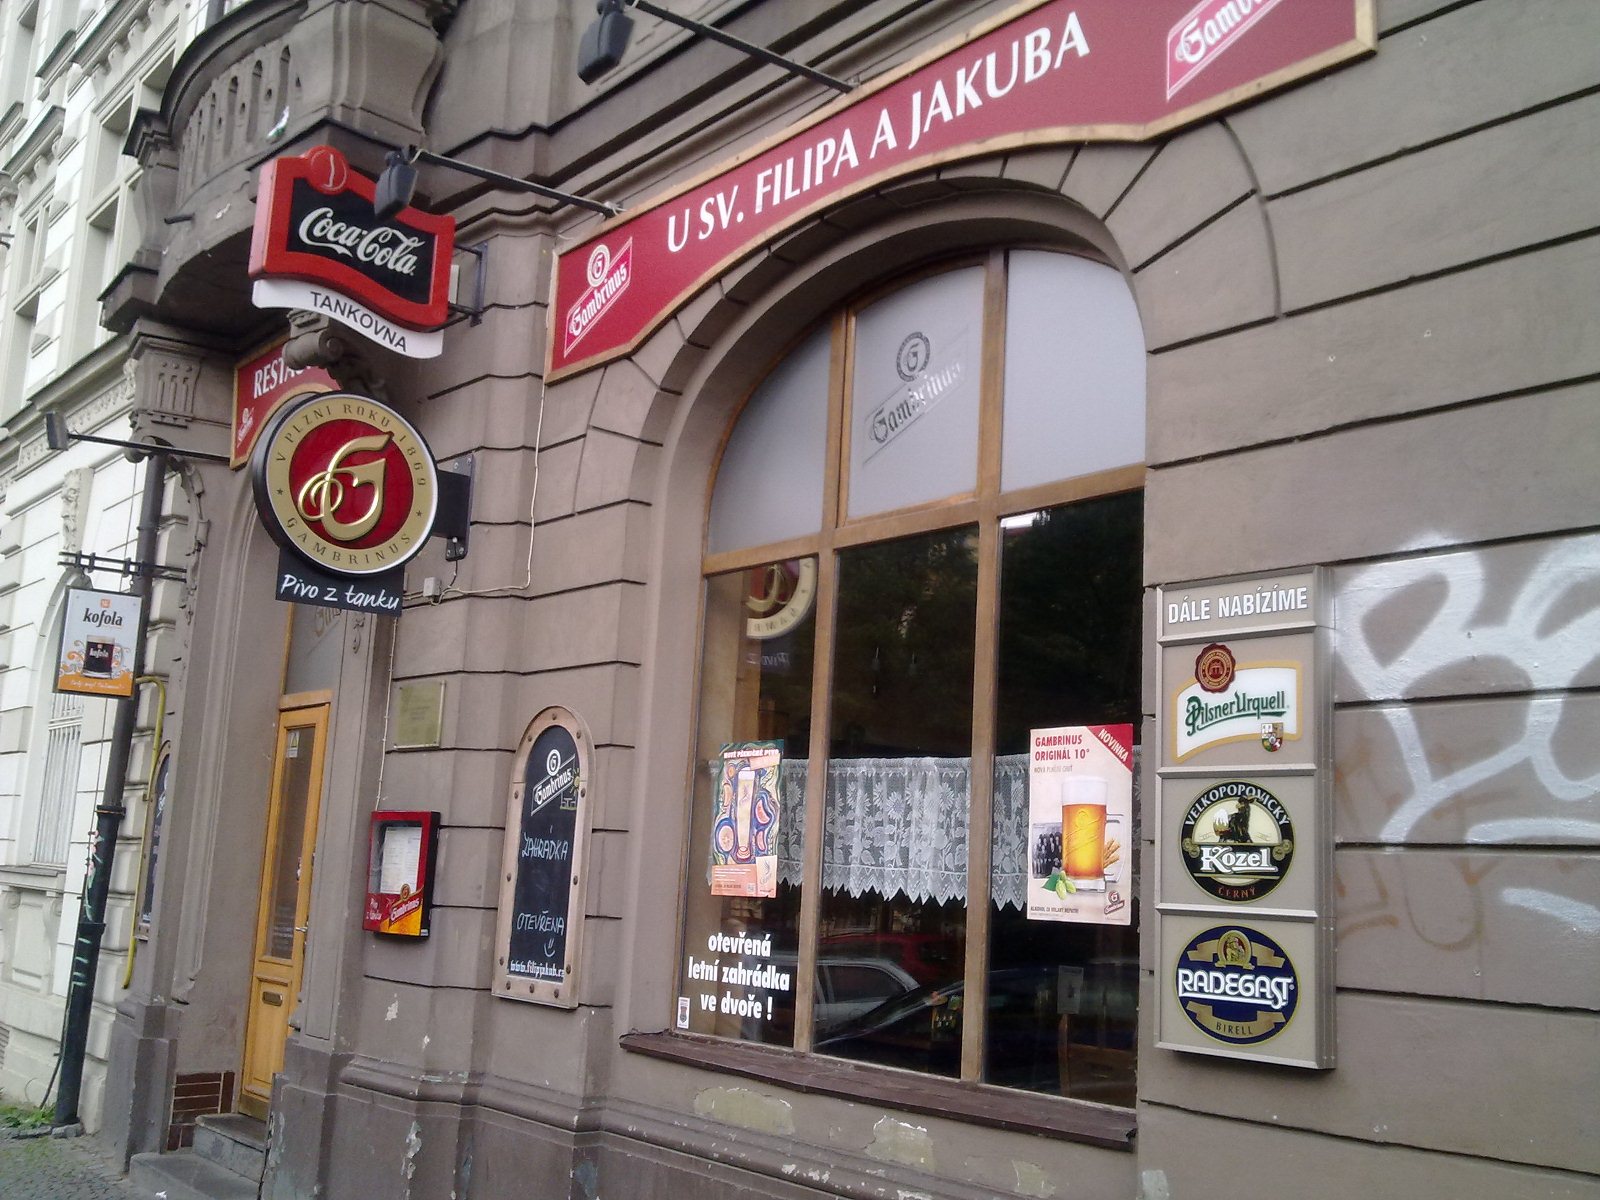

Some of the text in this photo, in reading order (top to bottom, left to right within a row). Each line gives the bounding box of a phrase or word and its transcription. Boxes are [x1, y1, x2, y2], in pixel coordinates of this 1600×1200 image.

[667, 11, 1091, 252] U SV. FILIPA A JAKUBA
[298, 206, 425, 277] Coca-Cola
[568, 261, 628, 337] Gambrinus
[310, 291, 407, 353] TANKOVNA
[284, 404, 332, 444] PLZNI
[342, 403, 392, 428] ROKU
[398, 434, 428, 487] 1869
[286, 516, 413, 566] GAMBRINUS
[280, 573, 400, 610] Pivo z tanku
[1168, 584, 1309, 624] DÁLE NABÍZÍME
[82, 607, 123, 628] kofola
[1185, 690, 1286, 737] Pilsner Urquell
[1034, 747, 1071, 762] ORIGINÁL
[1035, 734, 1083, 748] GAMBRINUS
[1097, 728, 1130, 762] NOVINKA
[534, 767, 573, 806] Gambrinus
[1199, 845, 1277, 874] Kozel
[708, 931, 772, 957] otevřená
[688, 956, 791, 991] letní zahrádka
[1178, 967, 1295, 1010] RADEGAST
[700, 993, 717, 1012] ve
[720, 990, 763, 1019] dvoře
[1216, 1020, 1254, 1036] BIRELL
